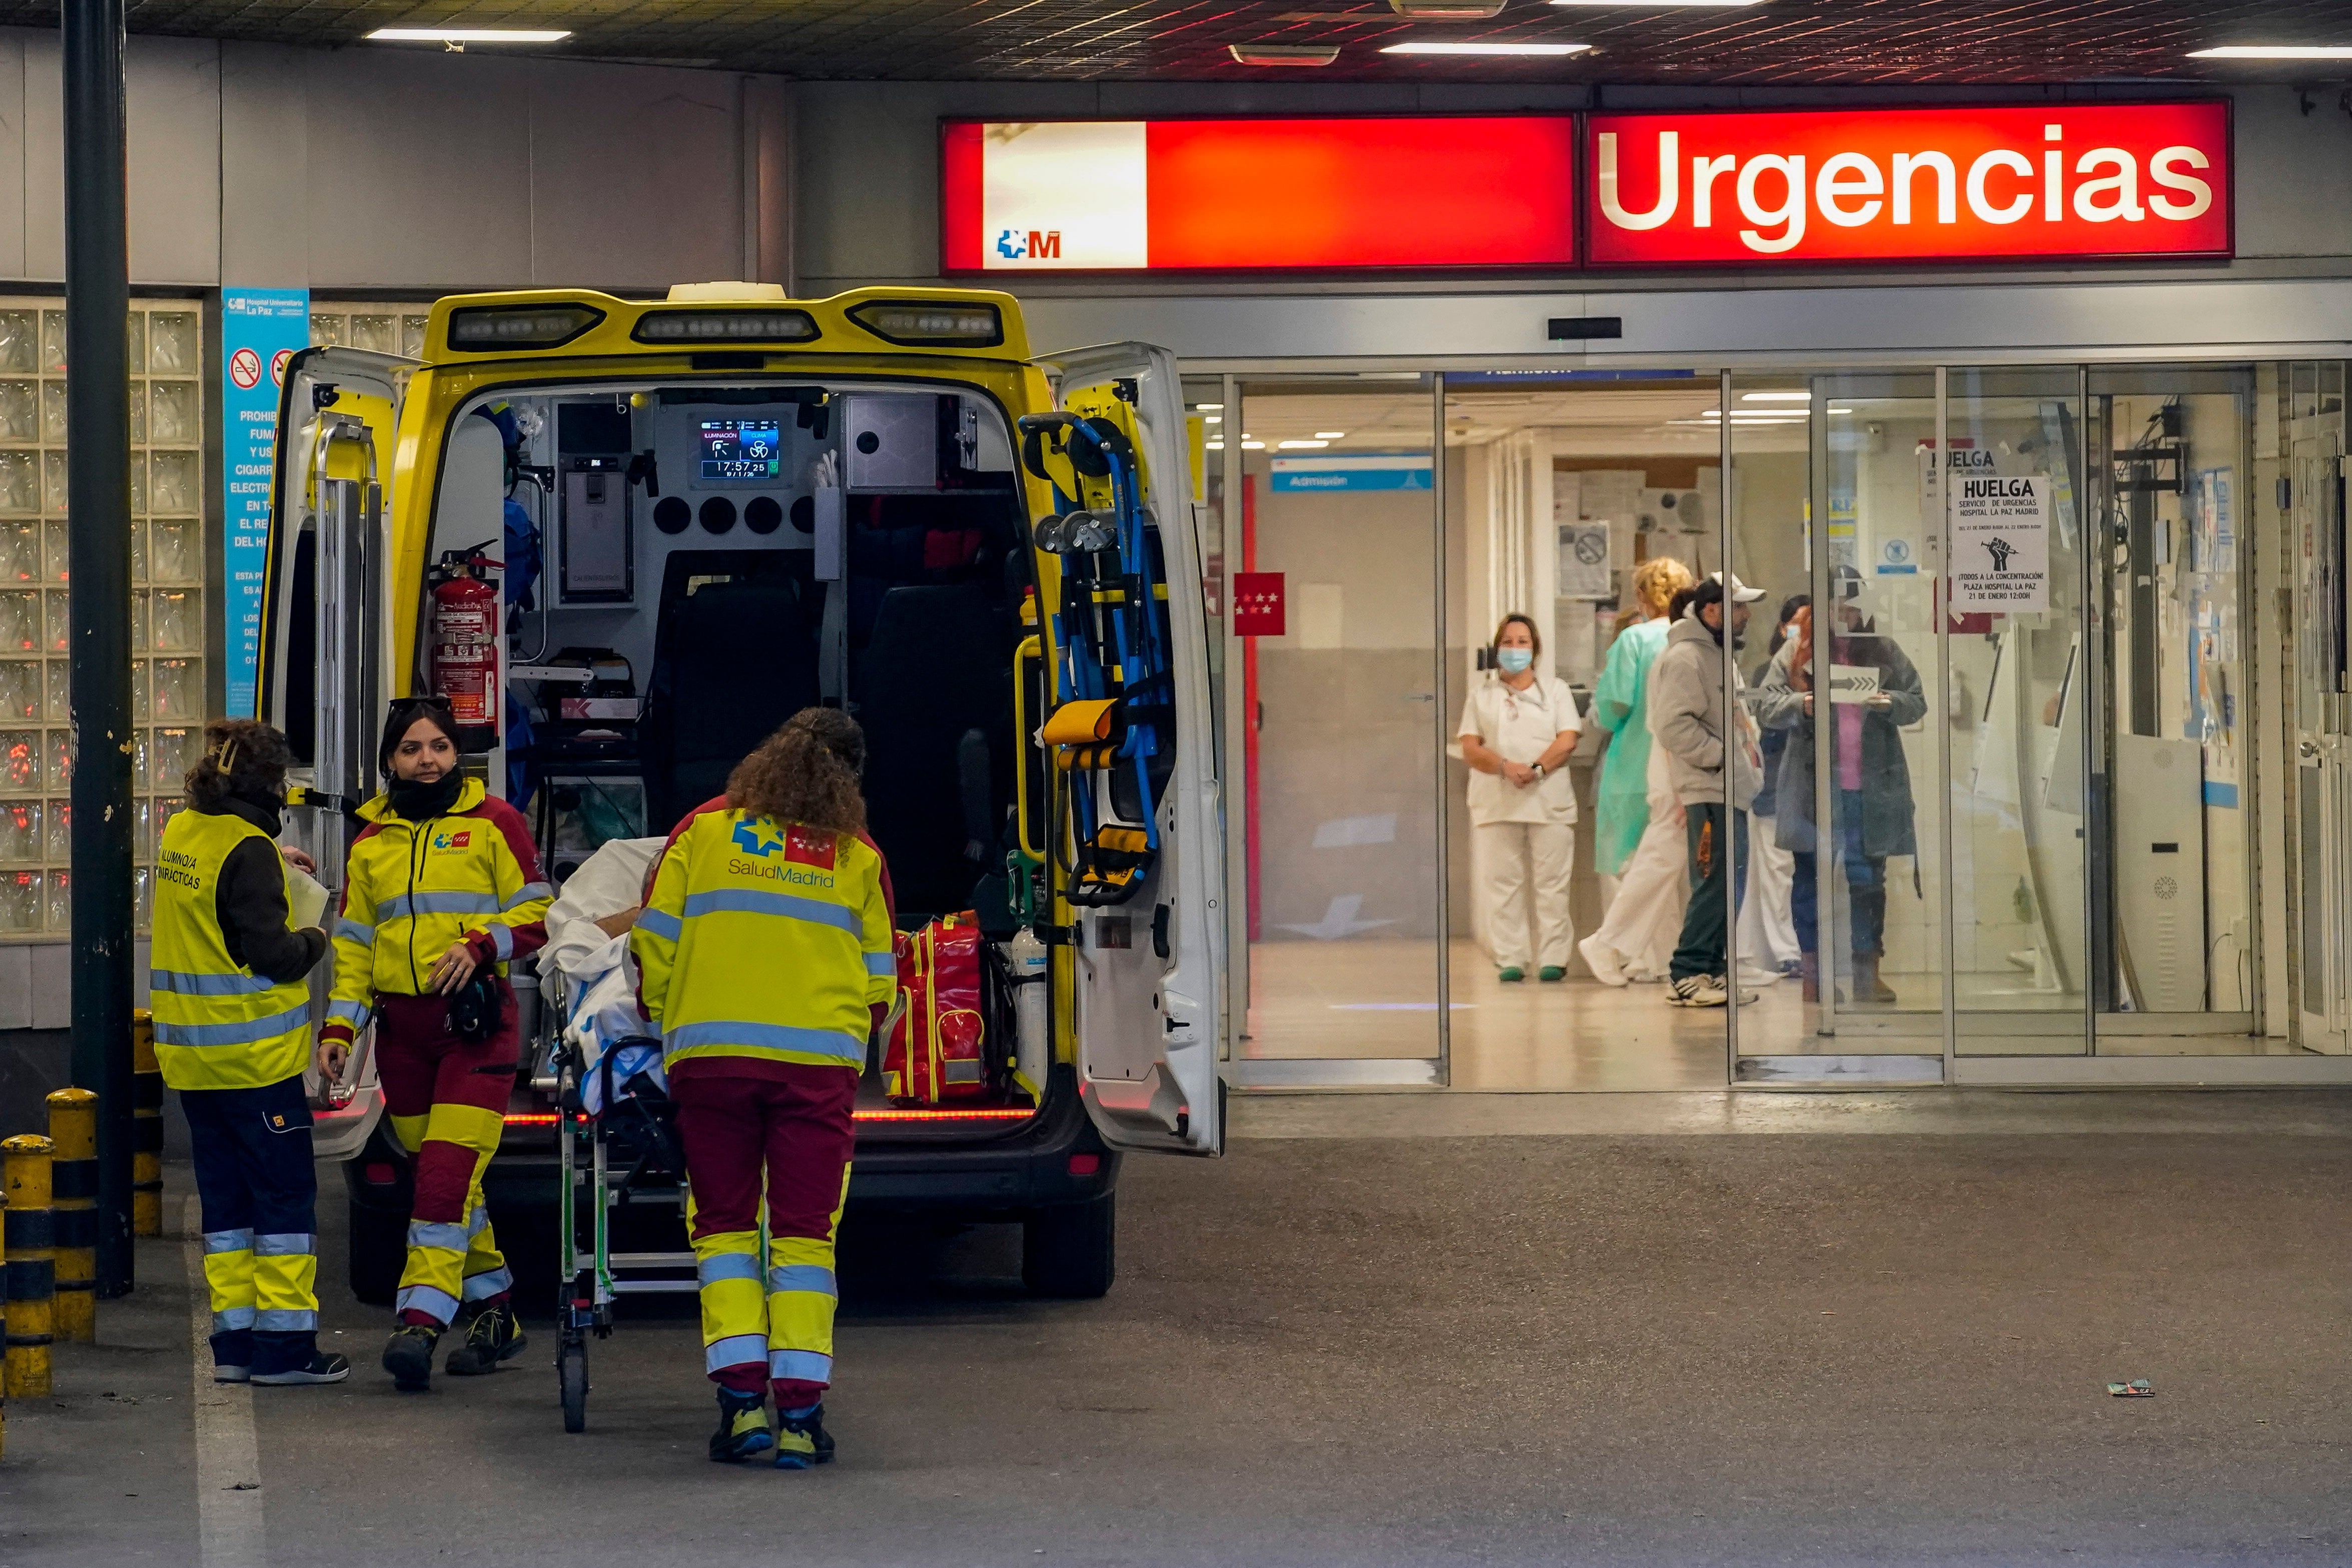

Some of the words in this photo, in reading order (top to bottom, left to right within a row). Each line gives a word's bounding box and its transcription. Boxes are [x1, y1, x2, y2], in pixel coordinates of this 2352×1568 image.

[1599, 124, 2212, 254] Urgencias
[247, 306, 256, 315] La
[258, 306, 272, 315] Paz
[250, 447, 257, 457] Y
[717, 462, 750, 471] 17:57
[1290, 476, 1348, 487] Admisión
[230, 482, 271, 493] ELECTR
[1964, 479, 2034, 498] HUELGA
[247, 500, 260, 511] EN
[2015, 507, 2039, 515] MADRID
[240, 518, 252, 529] EL
[235, 536, 254, 547] DEL
[235, 571, 254, 580] ESTA
[1996, 571, 2044, 580] CONCENTRACIÓN!
[244, 585, 254, 594] ES
[728, 859, 834, 888] SaludMadrid
